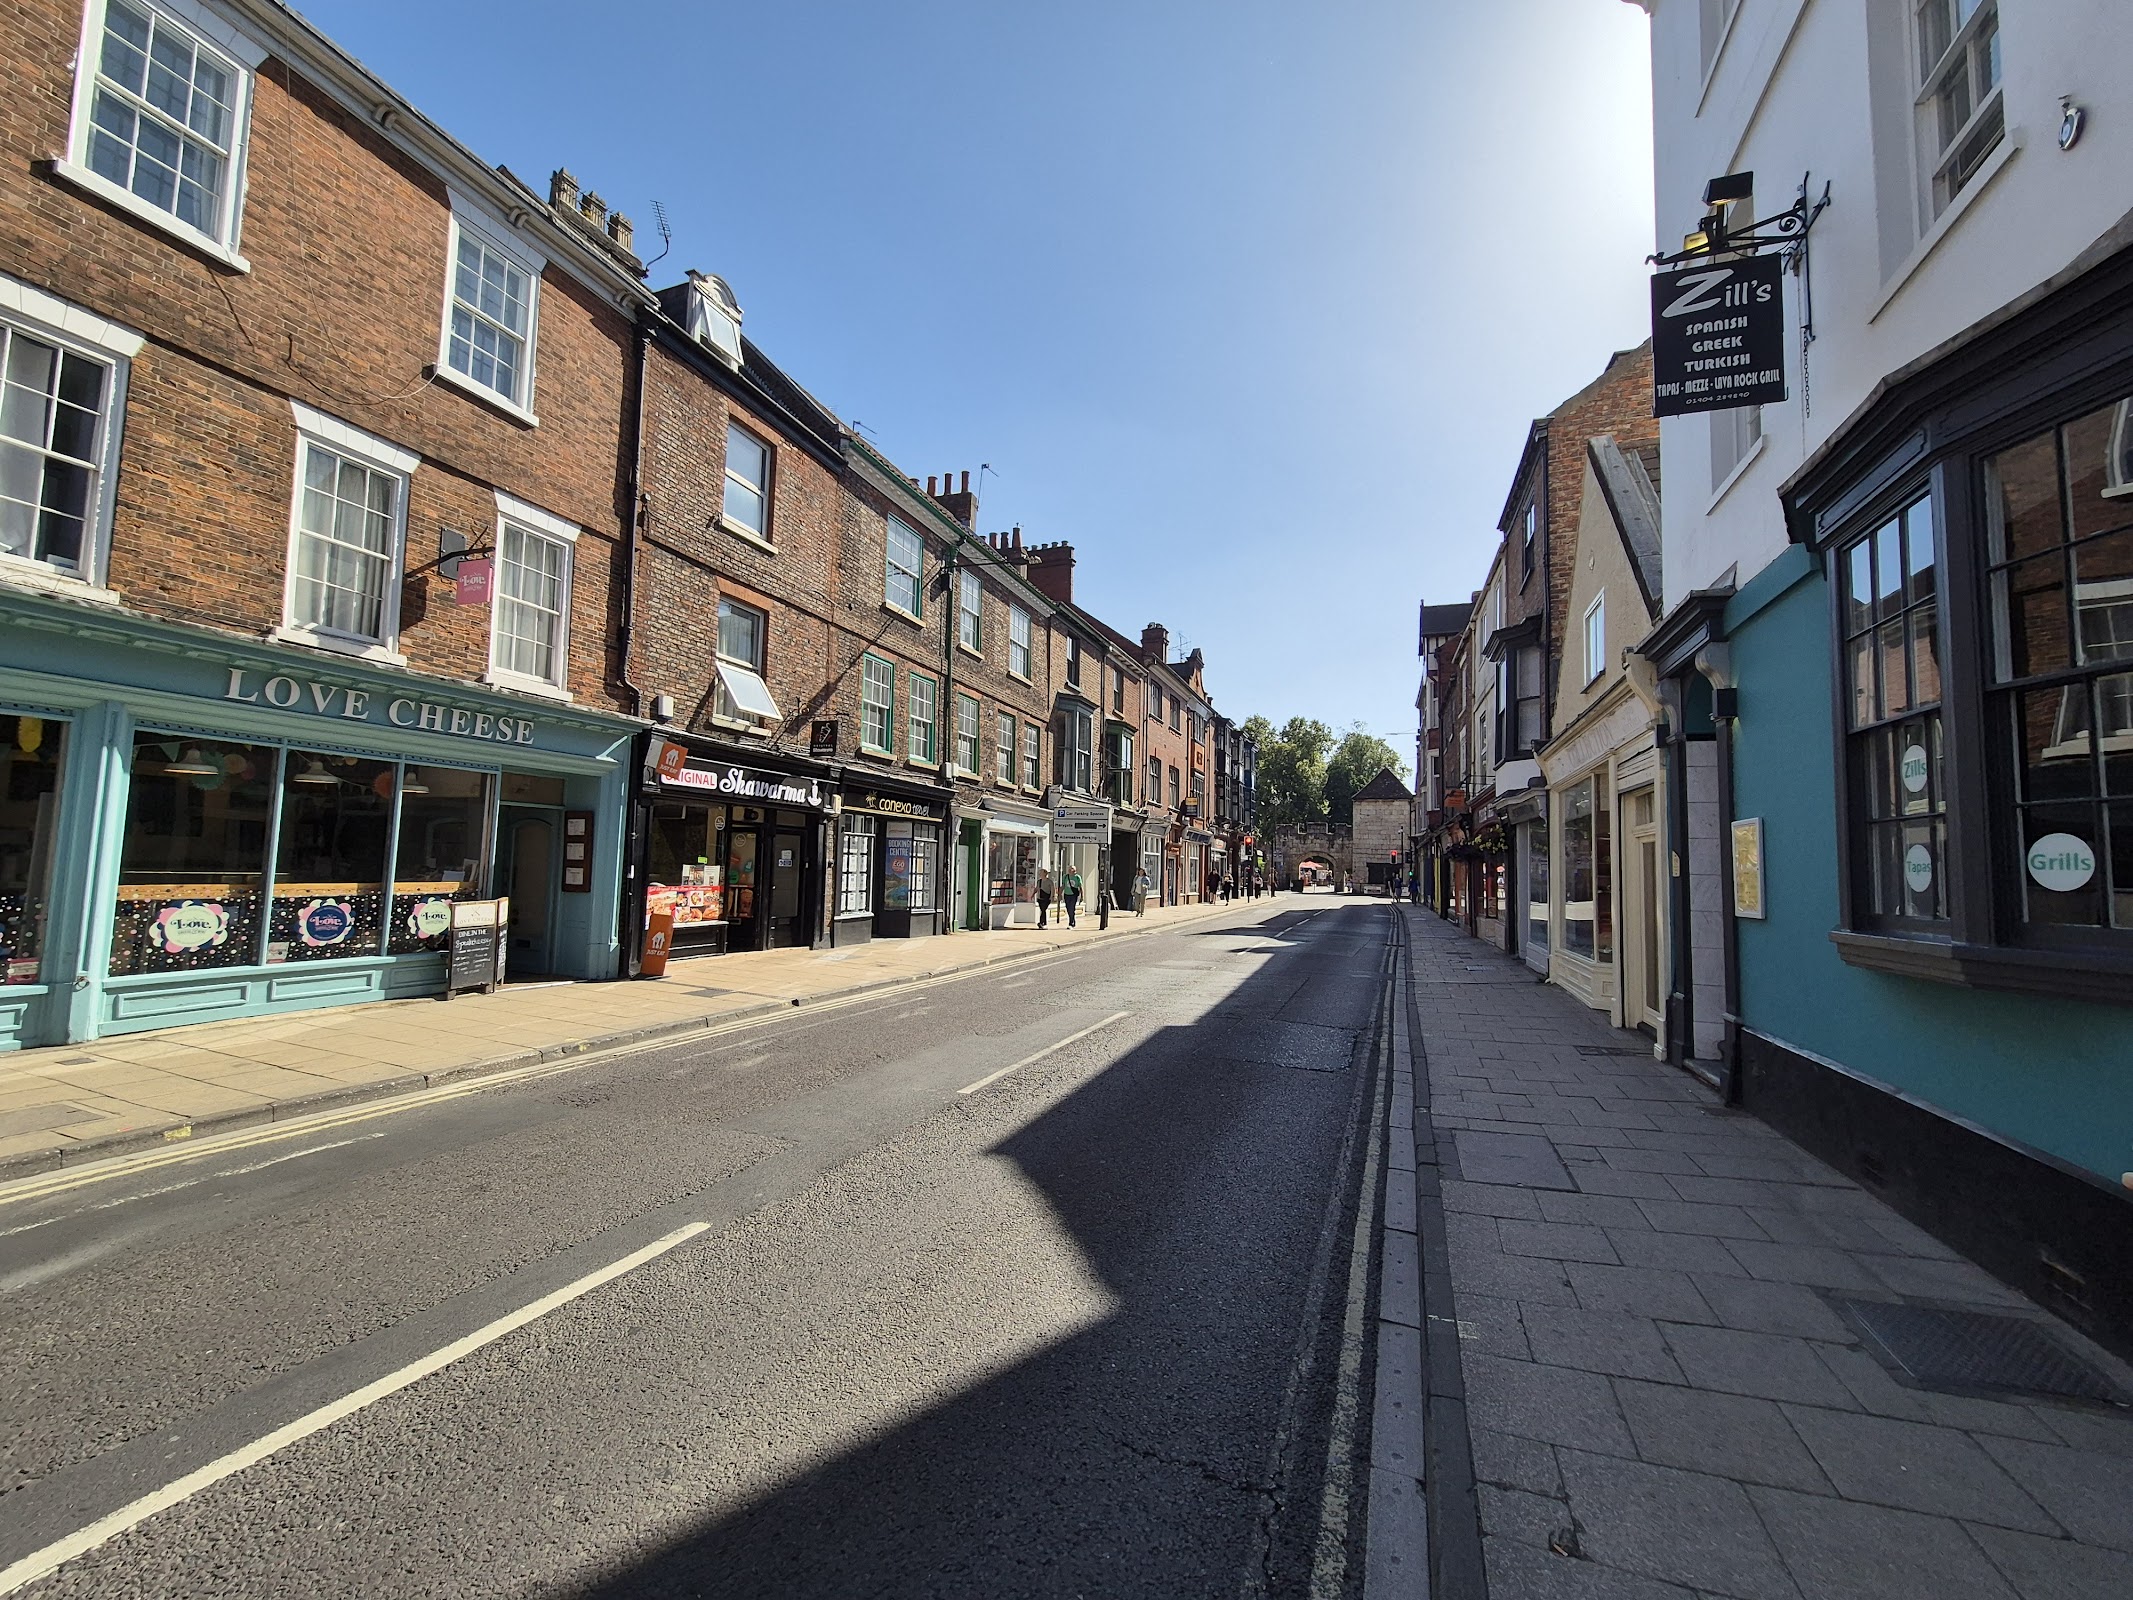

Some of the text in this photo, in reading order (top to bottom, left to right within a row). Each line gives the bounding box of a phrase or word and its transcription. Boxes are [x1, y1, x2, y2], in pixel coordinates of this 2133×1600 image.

[1661, 268, 1772, 318] Zill's
[1686, 316, 1748, 336] SPANISH
[1692, 335, 1743, 353] GREEK
[1684, 353, 1750, 373] TURKISH
[1657, 382, 1680, 398] TAPAS
[1685, 378, 1709, 394] MEZZE
[1714, 374, 1732, 390] LAVA
[1734, 372, 1758, 388] ROCK
[1760, 368, 1780, 383] GRILL
[224, 667, 535, 745] LOVE CHEESE
[659, 763, 670, 772] JUST
[1904, 760, 1927, 778] Zills
[665, 768, 806, 803] IGINAL Shawarma
[879, 798, 912, 814] conexo
[888, 839, 912, 848] BOOKING
[889, 847, 909, 857] CENTRE
[1907, 861, 1931, 876] Tapas
[2030, 852, 2092, 871] Grills
